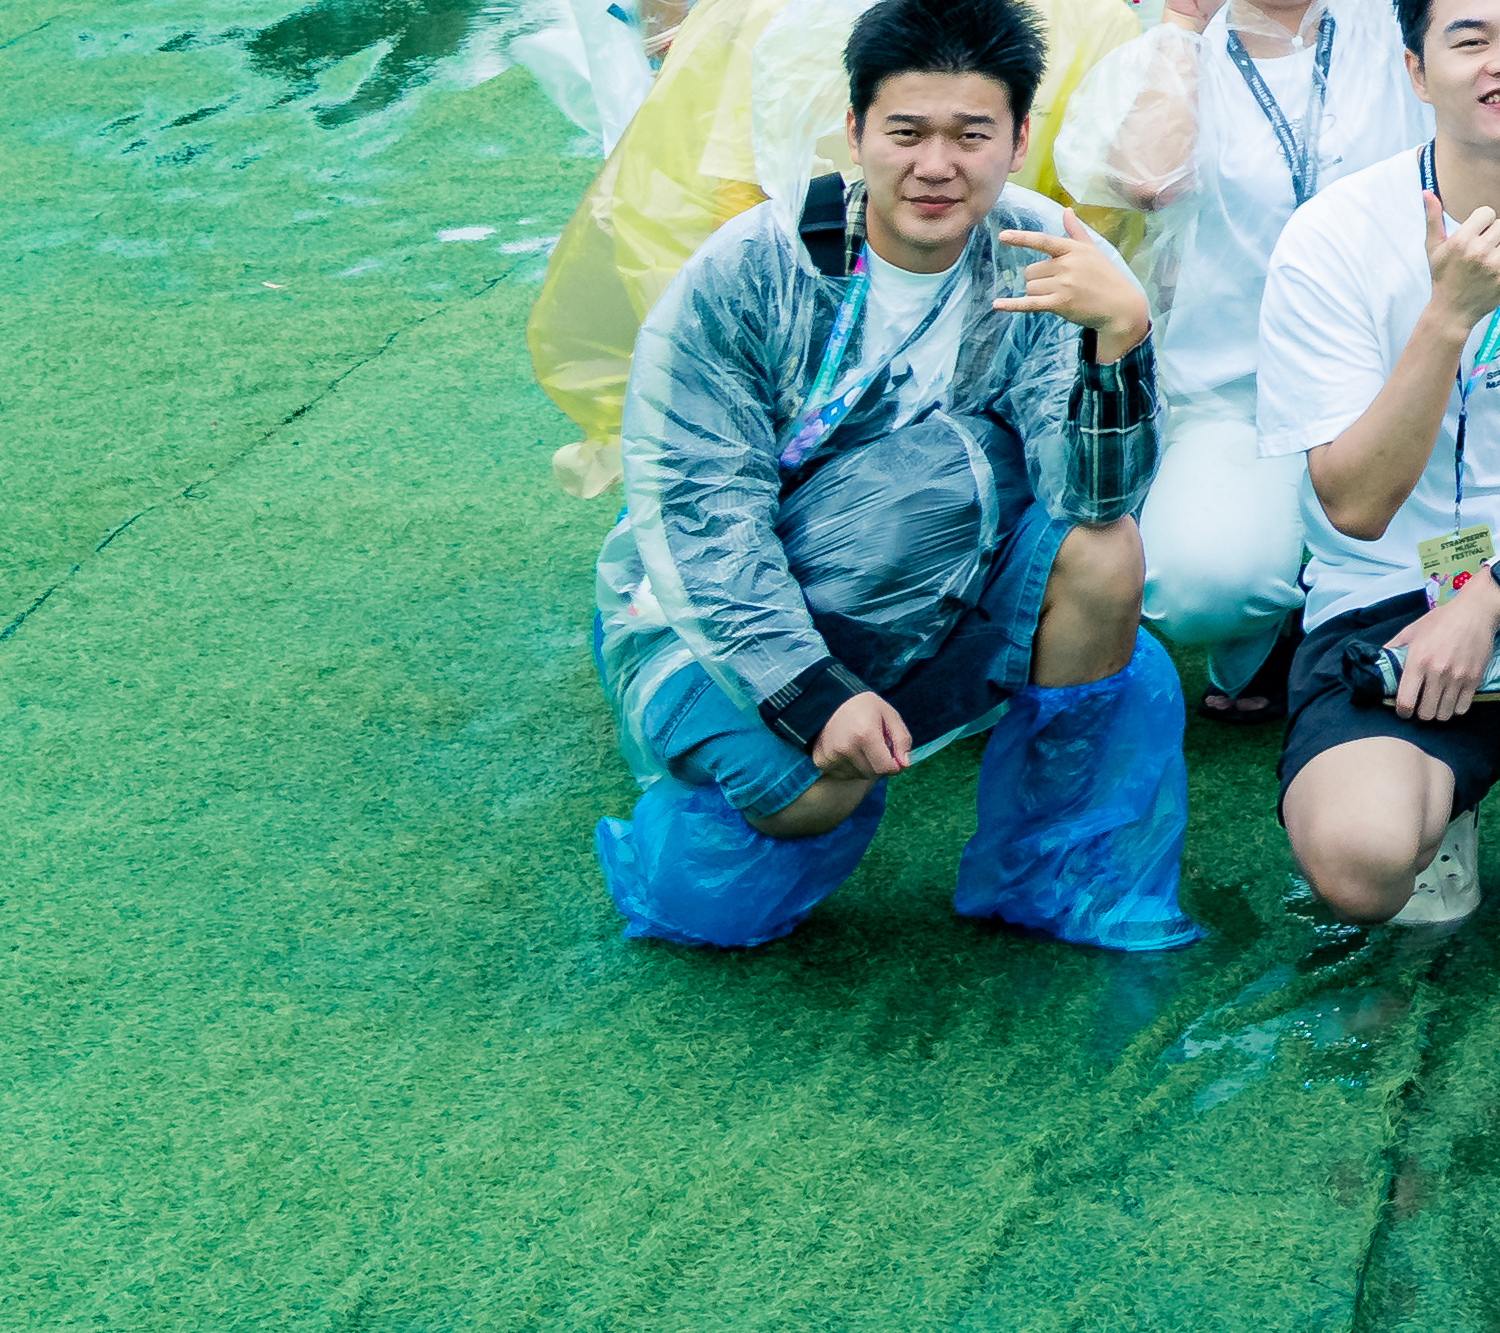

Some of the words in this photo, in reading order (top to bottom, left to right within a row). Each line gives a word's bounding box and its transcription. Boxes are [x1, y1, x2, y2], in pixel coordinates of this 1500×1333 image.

[1440, 530, 1489, 551] STRAWBERRY
[1454, 541, 1478, 553] MUSIC
[1451, 547, 1485, 562] FESTIVAL
